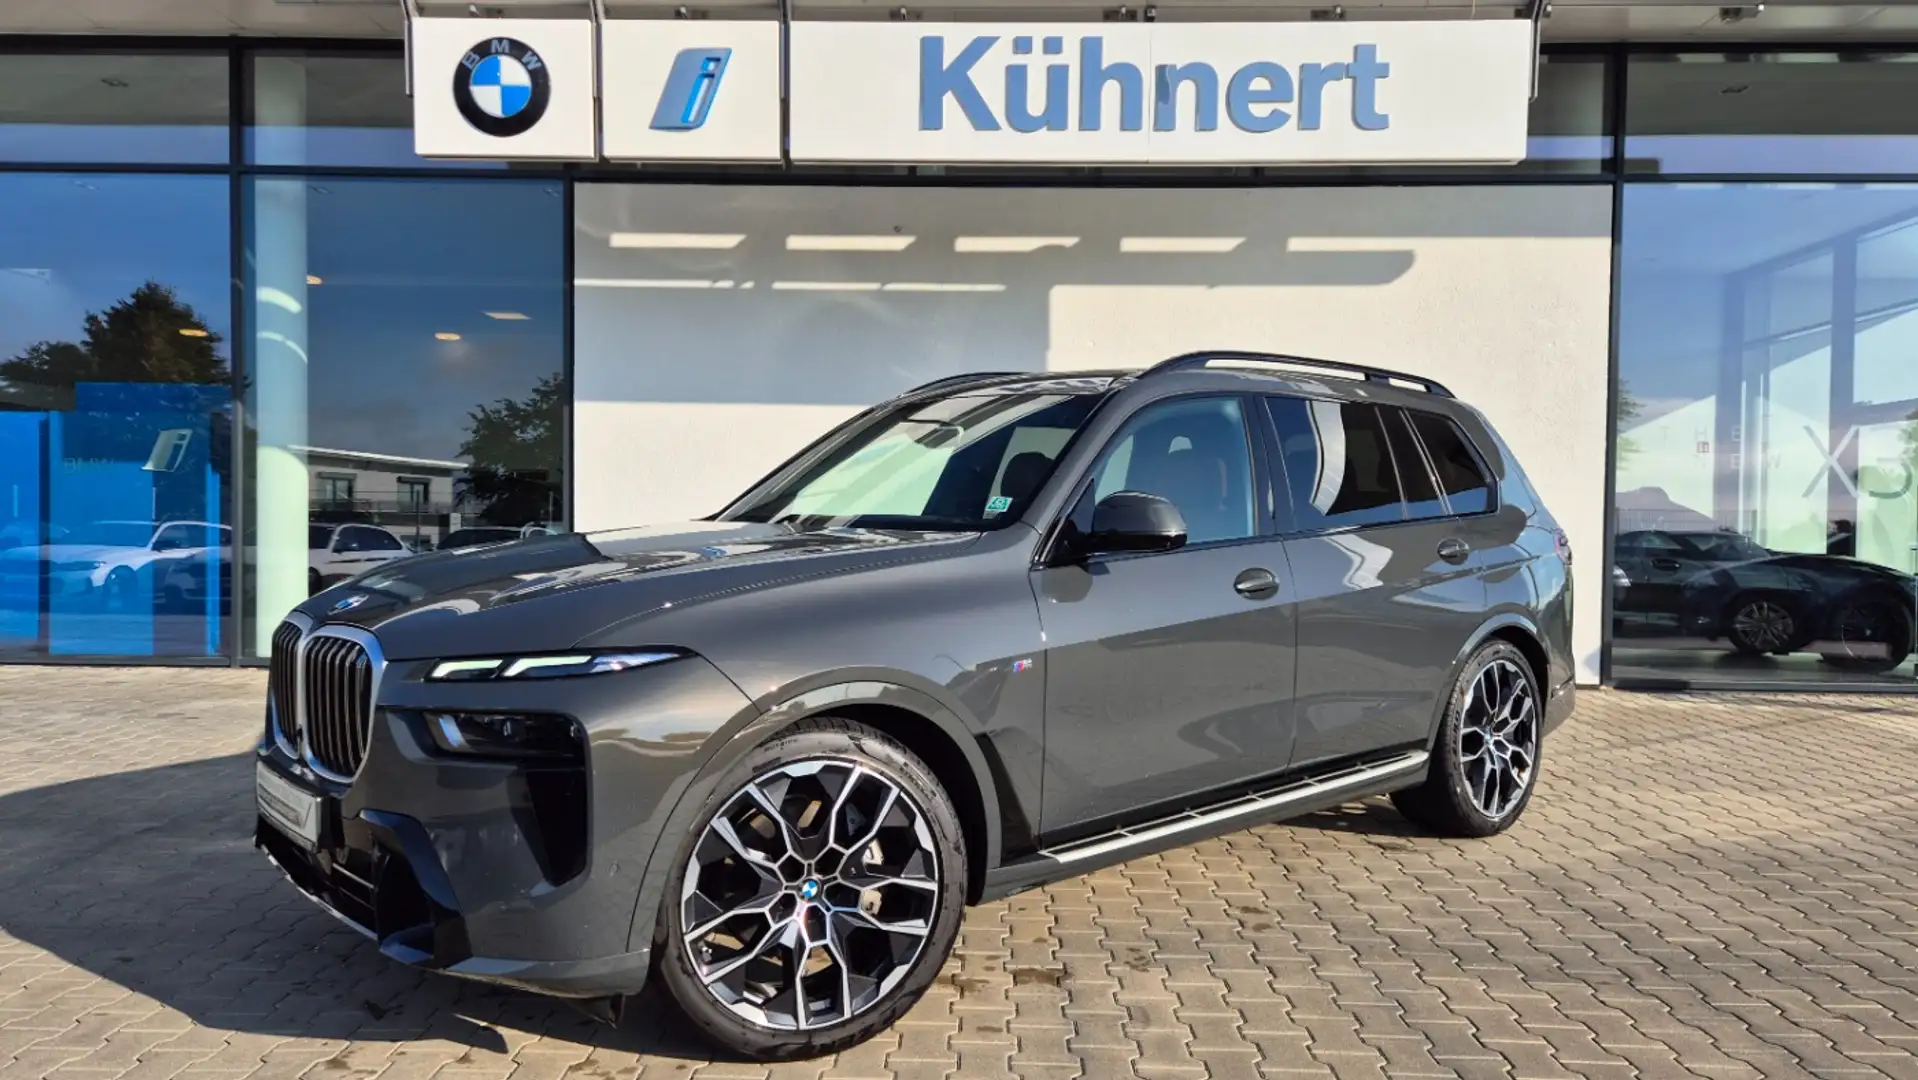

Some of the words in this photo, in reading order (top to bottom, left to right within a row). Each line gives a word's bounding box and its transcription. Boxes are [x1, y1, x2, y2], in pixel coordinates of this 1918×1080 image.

[461, 38, 542, 71] BMW
[918, 36, 1391, 134] Kühnert
[1801, 424, 1914, 499] X5
